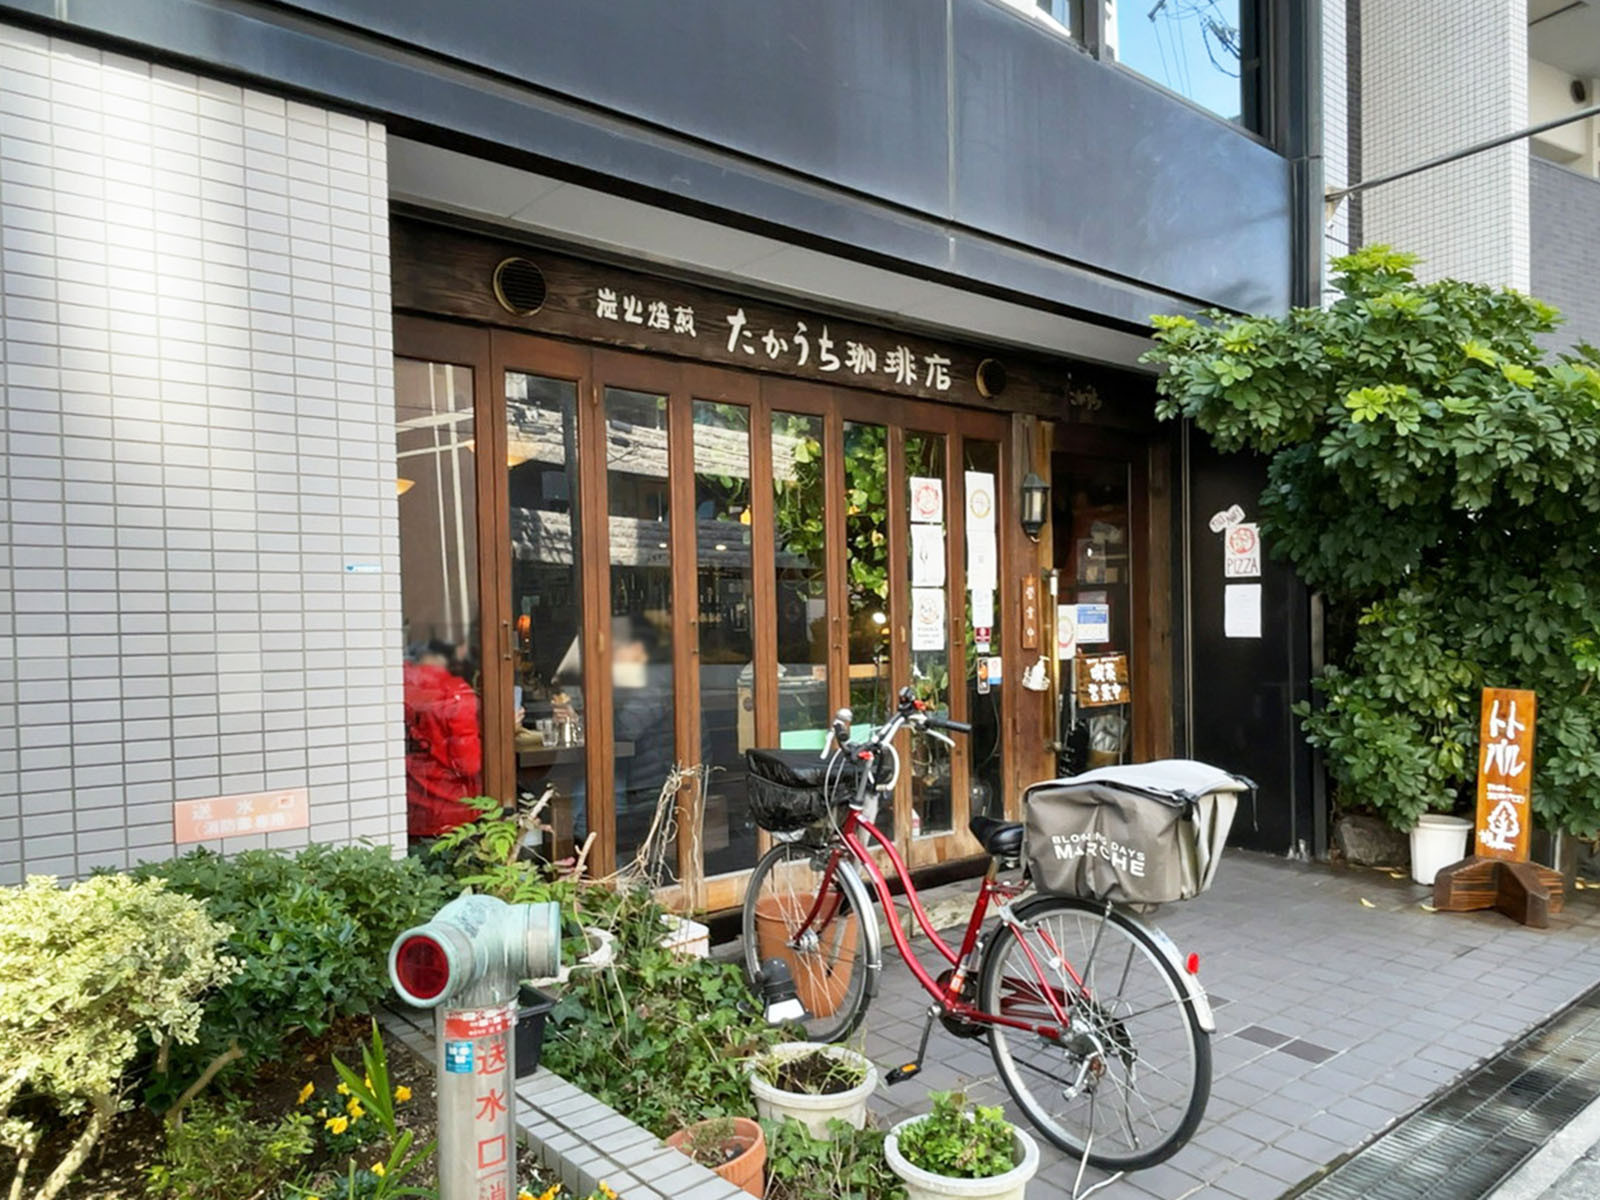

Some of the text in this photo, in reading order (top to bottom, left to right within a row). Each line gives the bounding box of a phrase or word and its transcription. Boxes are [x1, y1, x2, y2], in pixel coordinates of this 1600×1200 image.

[726, 308, 951, 390] たかうち珈琲店
[1227, 557, 1259, 575] PIZZA
[1111, 841, 1145, 861] DAYS
